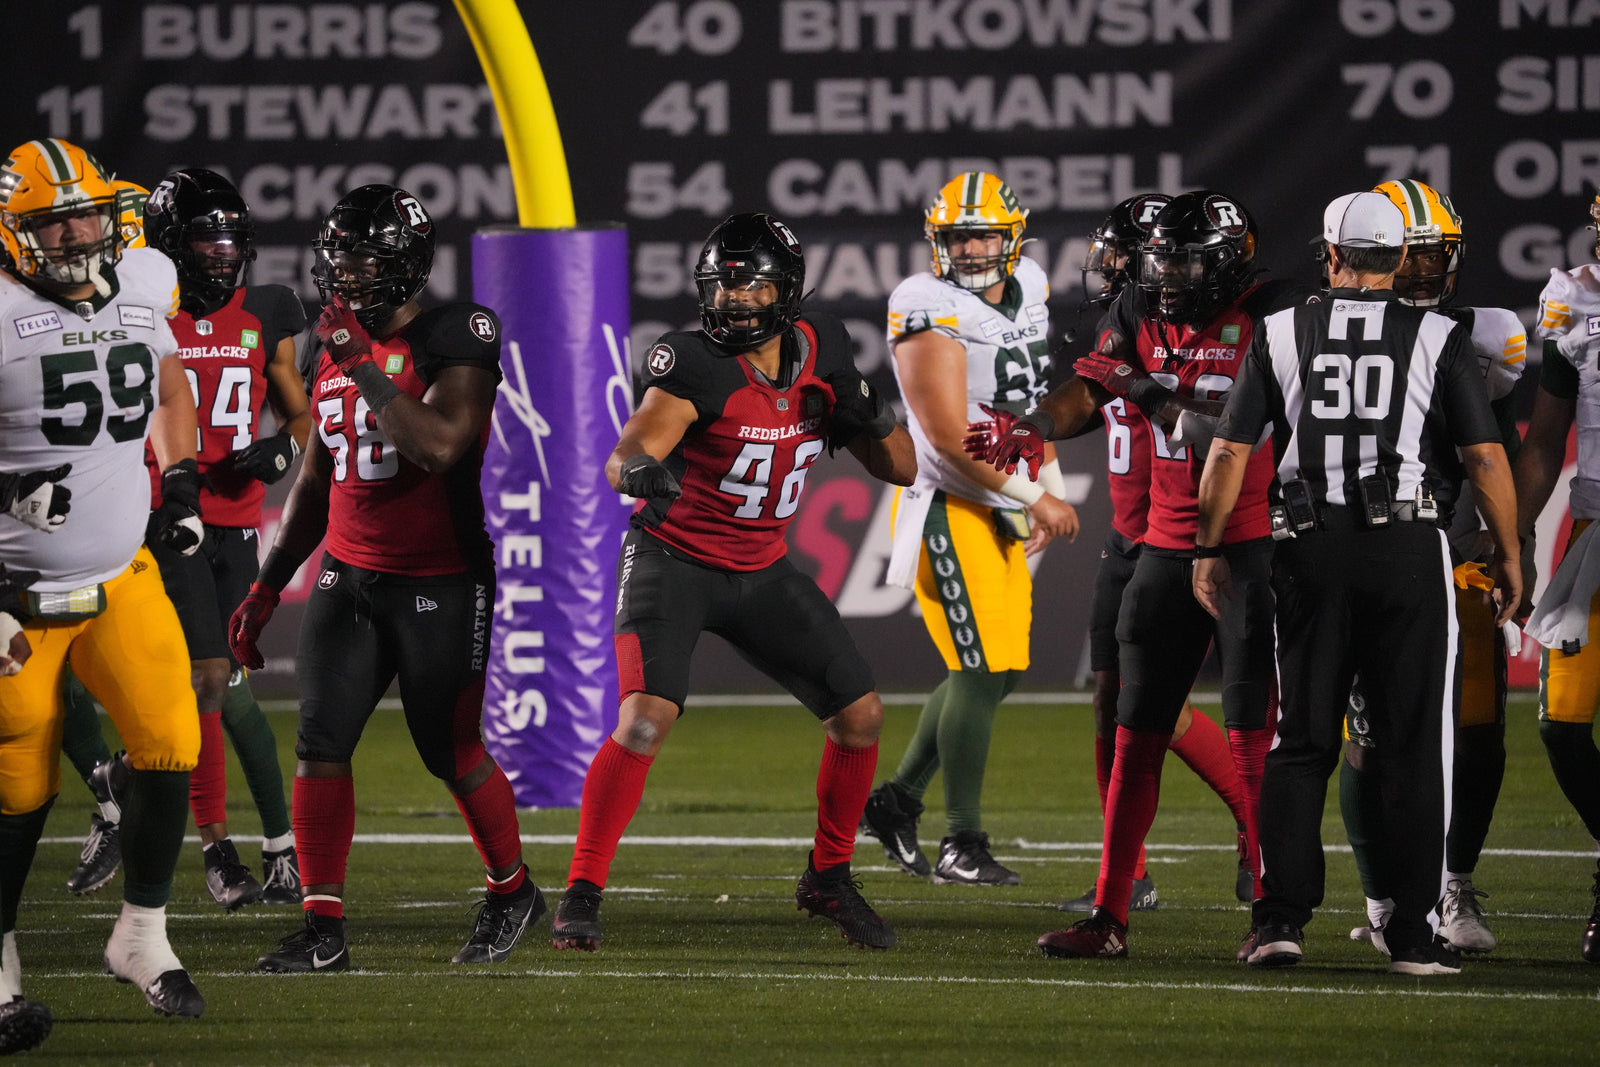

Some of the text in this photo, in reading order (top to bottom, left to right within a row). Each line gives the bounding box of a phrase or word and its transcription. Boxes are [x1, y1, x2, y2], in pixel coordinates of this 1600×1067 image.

[69, 5, 441, 57] 1 BURRIS
[630, 0, 1231, 53] 40 BITKOWSKI
[38, 84, 502, 139] 11 STEWART
[641, 71, 1173, 135] 41 LEHMANN
[1342, 61, 1452, 119] 70
[627, 162, 731, 218] 54
[1366, 146, 1449, 196] 71
[19, 315, 59, 333] TELUS
[62, 329, 129, 346] ELKS
[243, 333, 257, 345] TD
[1002, 325, 1039, 344] ELKS
[40, 342, 155, 447] 59
[1311, 353, 1395, 421] 30
[318, 396, 400, 482] 58
[738, 418, 819, 441] REDBLACKS
[718, 438, 826, 520] 46
[472, 584, 486, 672] RNATION
[501, 481, 548, 731] TELUS
